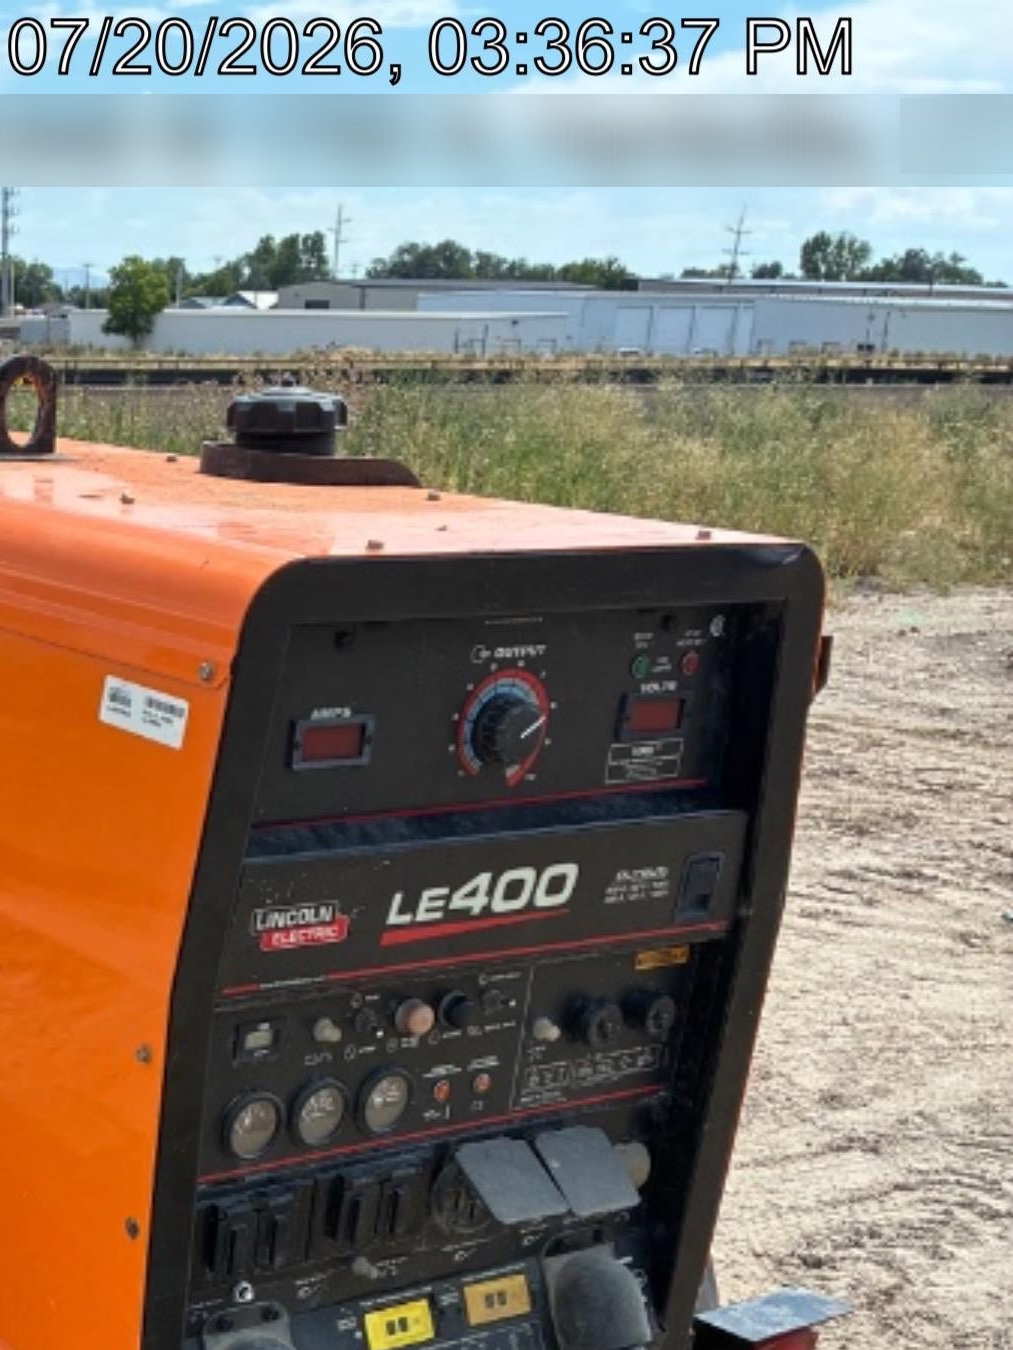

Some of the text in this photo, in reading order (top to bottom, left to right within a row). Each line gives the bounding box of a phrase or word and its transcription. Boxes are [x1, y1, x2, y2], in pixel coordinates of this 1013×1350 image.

[310, 706, 352, 721] AMPS
[386, 862, 580, 926] LE400
[255, 905, 334, 931] LINCOLN
[271, 924, 341, 945] ELECTRIC
